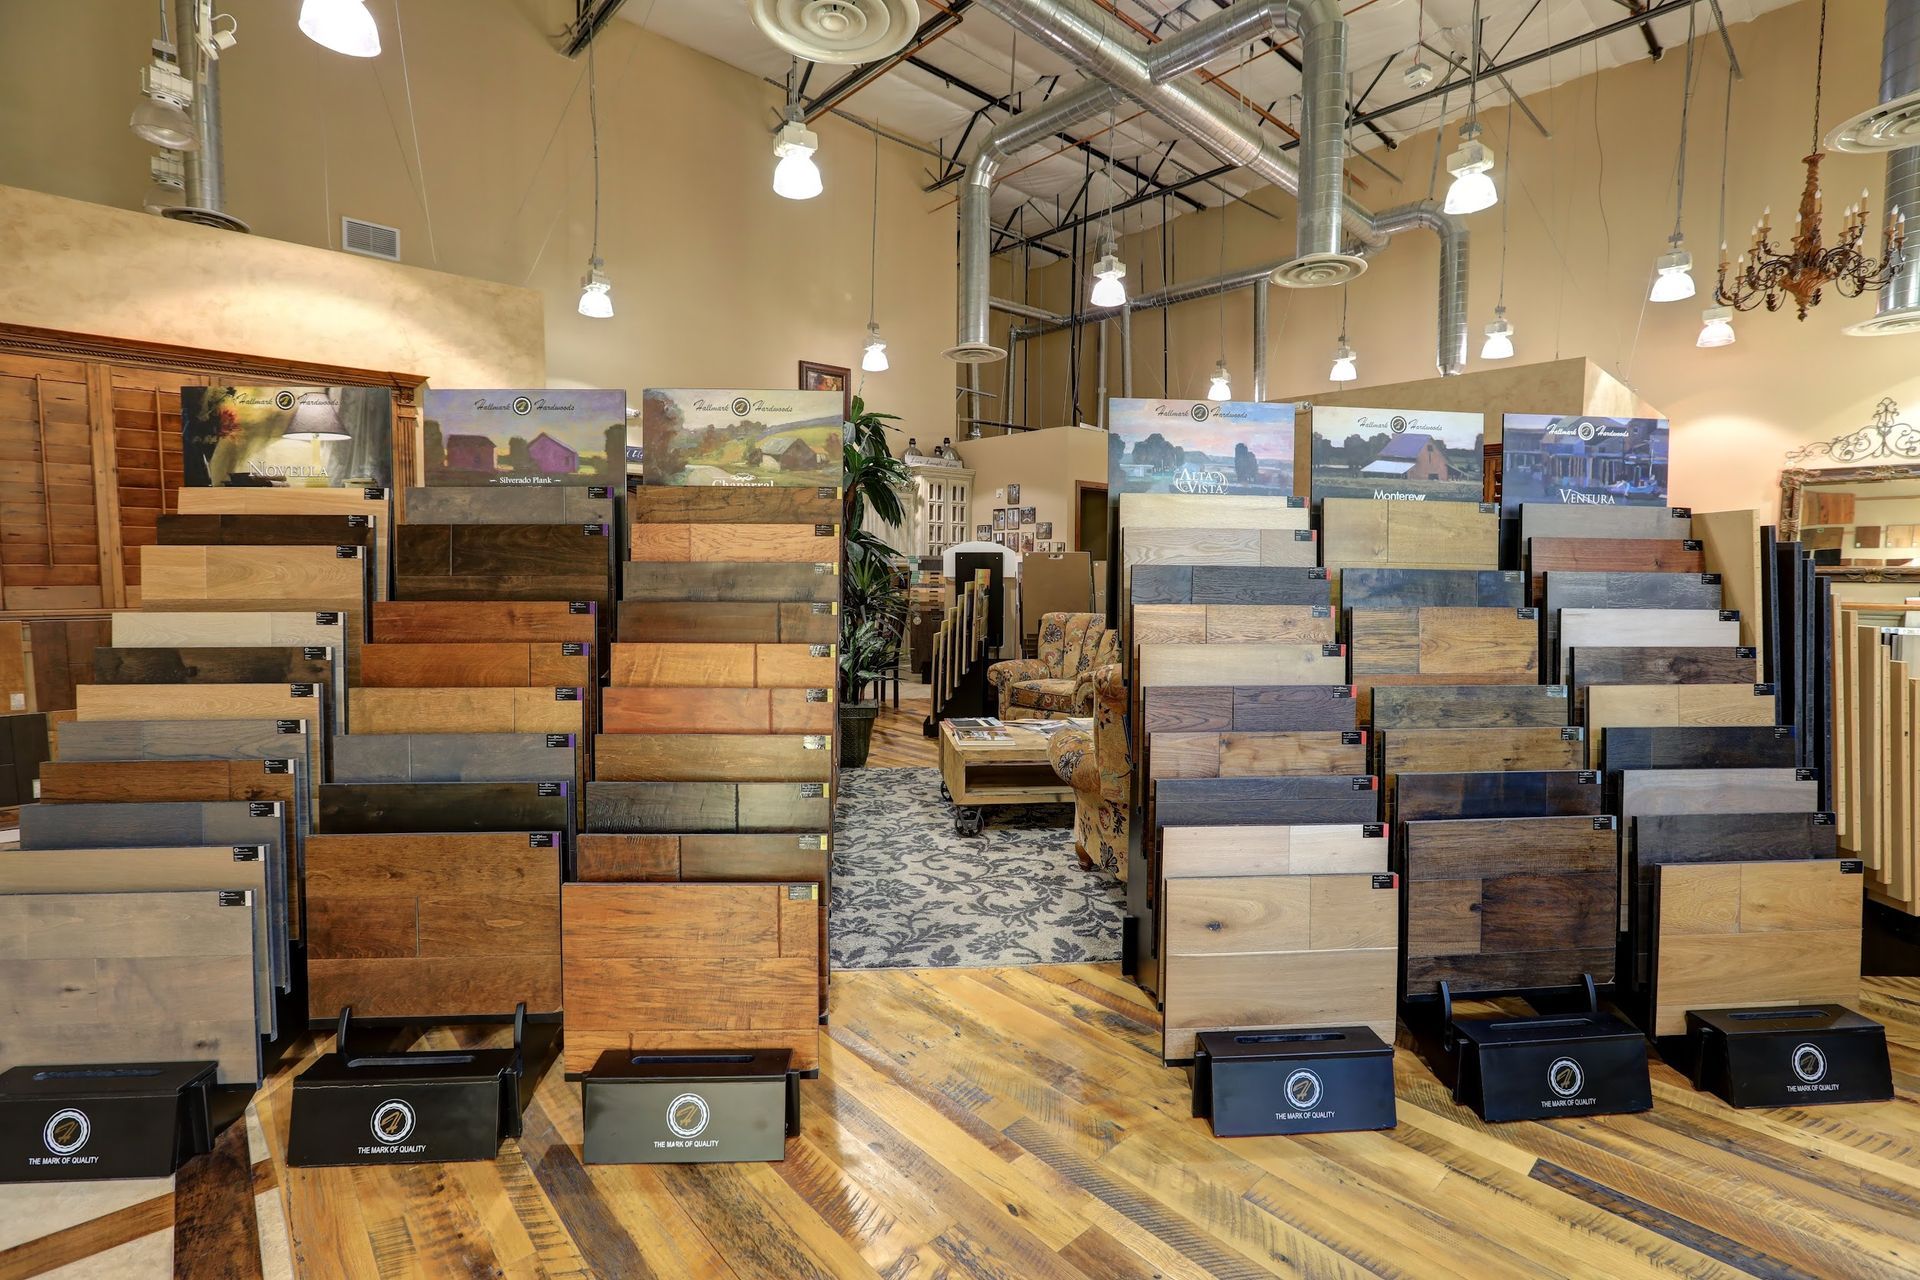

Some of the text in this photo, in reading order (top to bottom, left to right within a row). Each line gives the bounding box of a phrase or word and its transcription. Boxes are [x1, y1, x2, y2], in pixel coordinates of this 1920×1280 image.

[235, 393, 339, 406] Hallmark Hardwoods
[474, 398, 575, 412] Hallmark Hardwoods
[693, 399, 793, 413] Hallmark Hardwoods
[1155, 404, 1248, 419] Hallmark Hardwoods
[1357, 416, 1443, 431] Hallmark Hardwoods
[1546, 423, 1629, 437] Hallmark Hardwoods
[500, 476, 552, 484] Silverado Plank
[1180, 467, 1213, 481] ALTA
[1187, 480, 1223, 494] VISTA
[1560, 488, 1616, 505] VENTURA
[1818, 1083, 1840, 1091] QUALITY
[1541, 1100, 1552, 1108] THE
[1574, 1097, 1597, 1106] QUALITY
[1275, 1110, 1336, 1120] THE MARK OF QUALITY
[357, 1144, 427, 1155] THE MARK OF QUALITY
[684, 1140, 693, 1148] OF
[693, 1139, 720, 1148] QUALITY
[28, 1155, 99, 1165] THE MARK OF QUALITY
